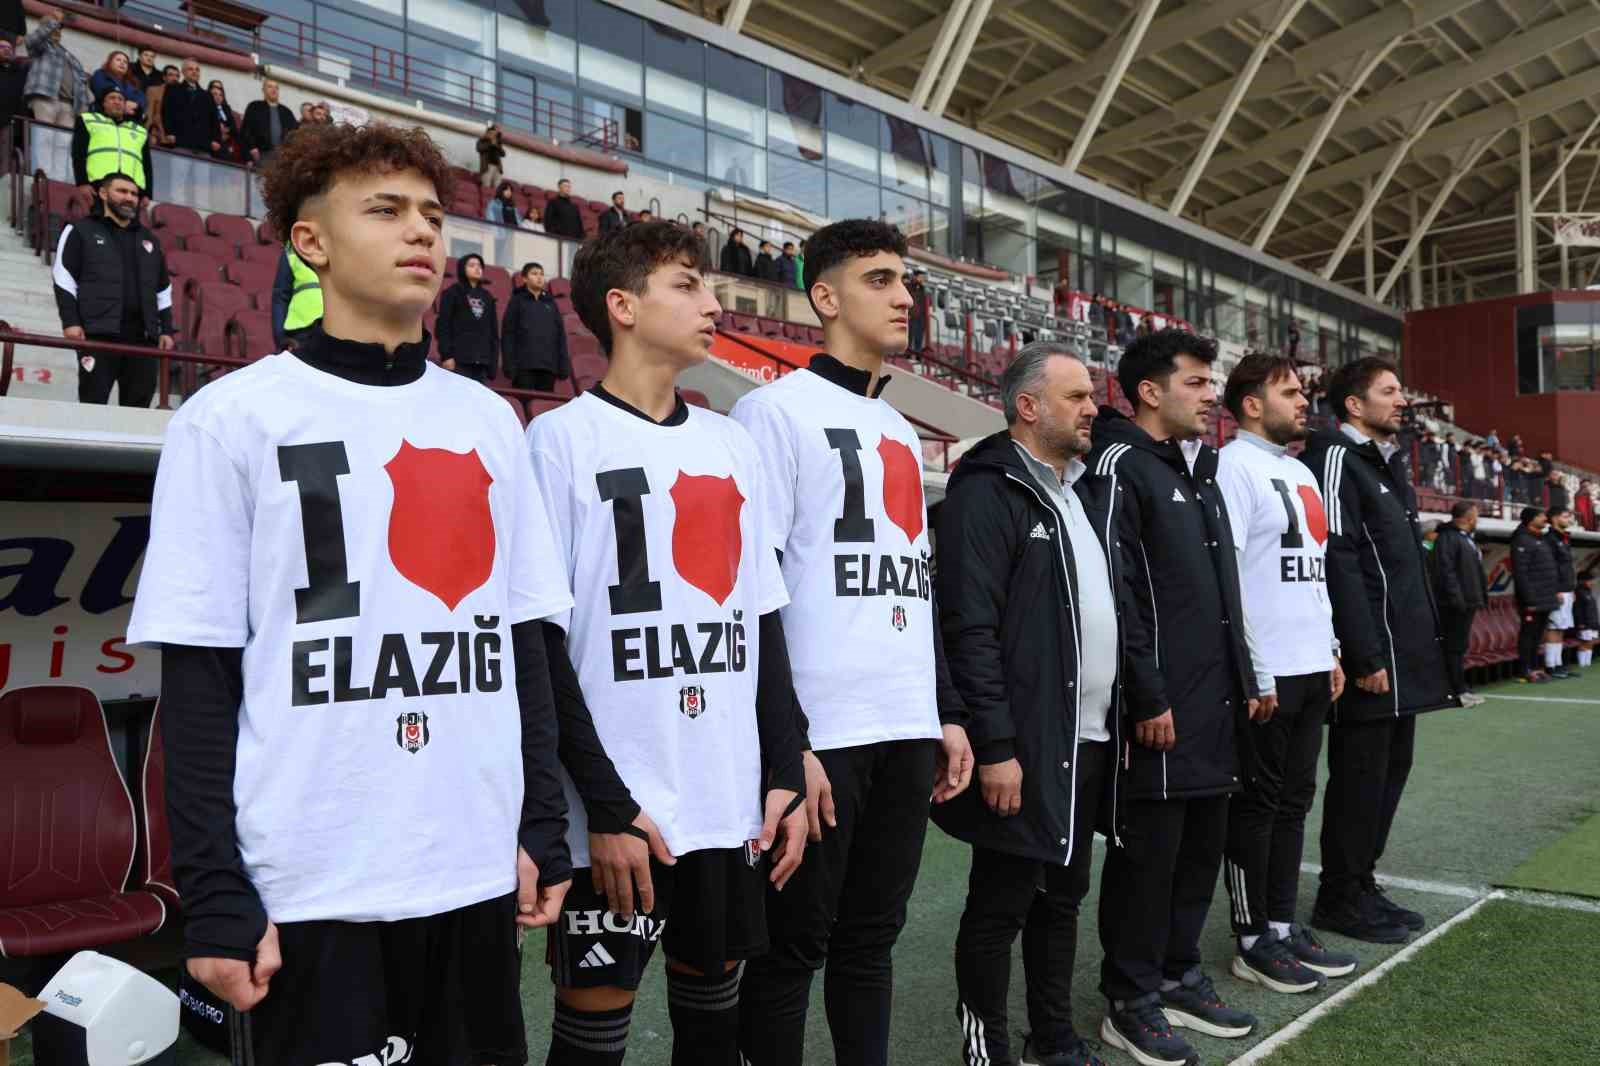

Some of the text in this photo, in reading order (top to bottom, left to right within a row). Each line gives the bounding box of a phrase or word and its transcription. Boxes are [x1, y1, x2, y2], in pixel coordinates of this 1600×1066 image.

[824, 428, 875, 542] I
[1270, 478, 1304, 548] I
[277, 440, 360, 624] I
[595, 467, 662, 615] I
[834, 550, 930, 601] ELAZIĞ
[291, 615, 502, 707] ELAZIĞ
[611, 609, 746, 682] ELAZIĞ
